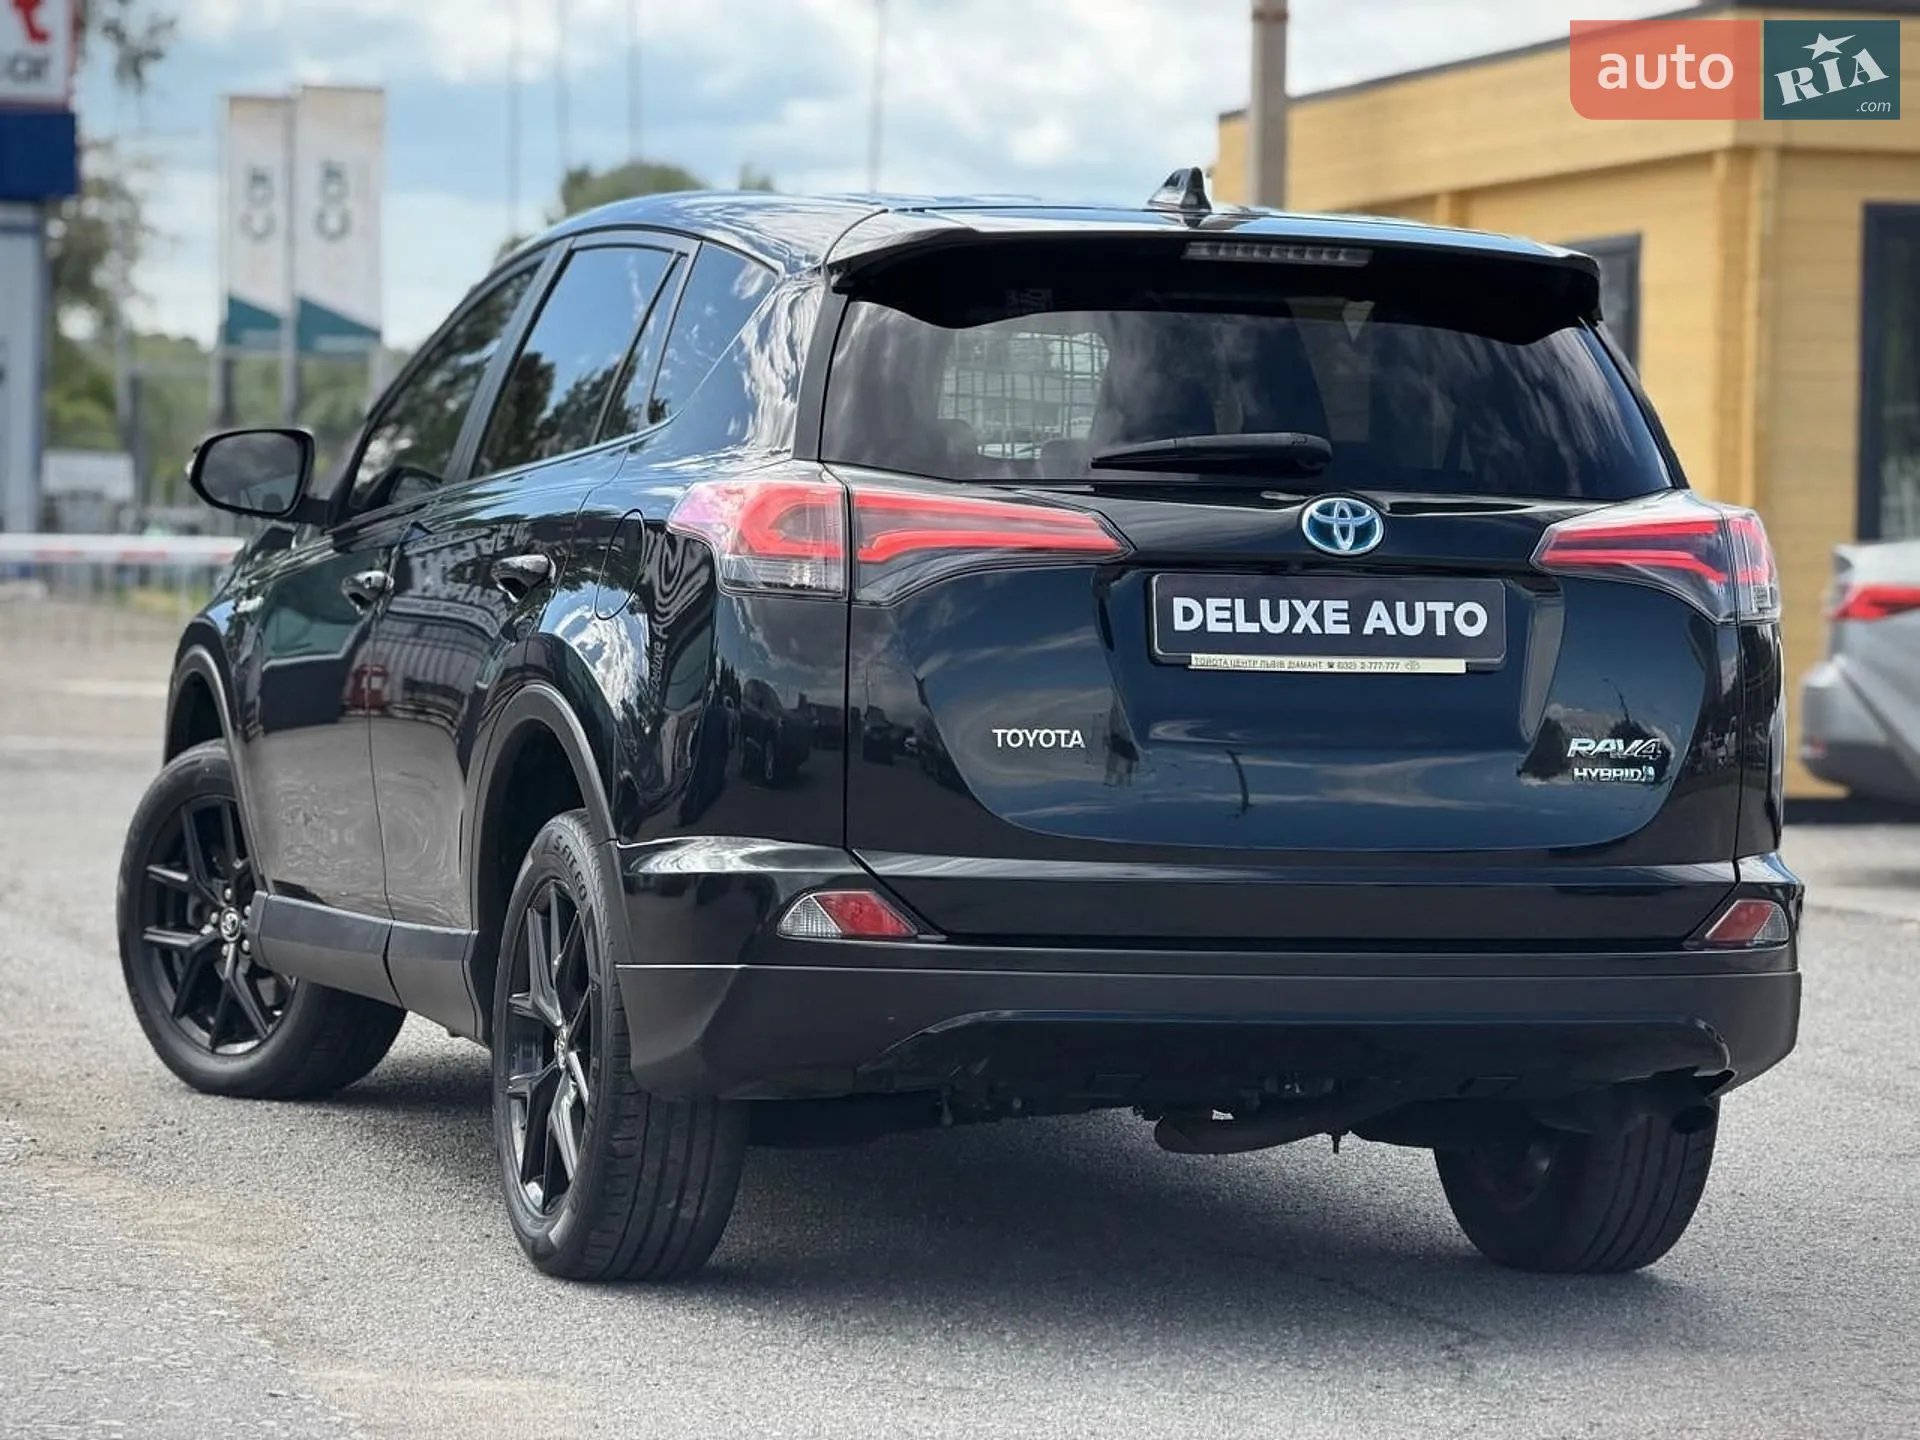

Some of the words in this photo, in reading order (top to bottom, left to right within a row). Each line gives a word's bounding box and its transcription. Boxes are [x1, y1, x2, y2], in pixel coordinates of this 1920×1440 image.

[1172, 596, 1351, 635] DELUXE
[1362, 601, 1488, 637] AUTO
[992, 728, 1085, 749] TOYOTA
[1567, 737, 1662, 760] RAV4
[1573, 767, 1642, 782] HYBRID
